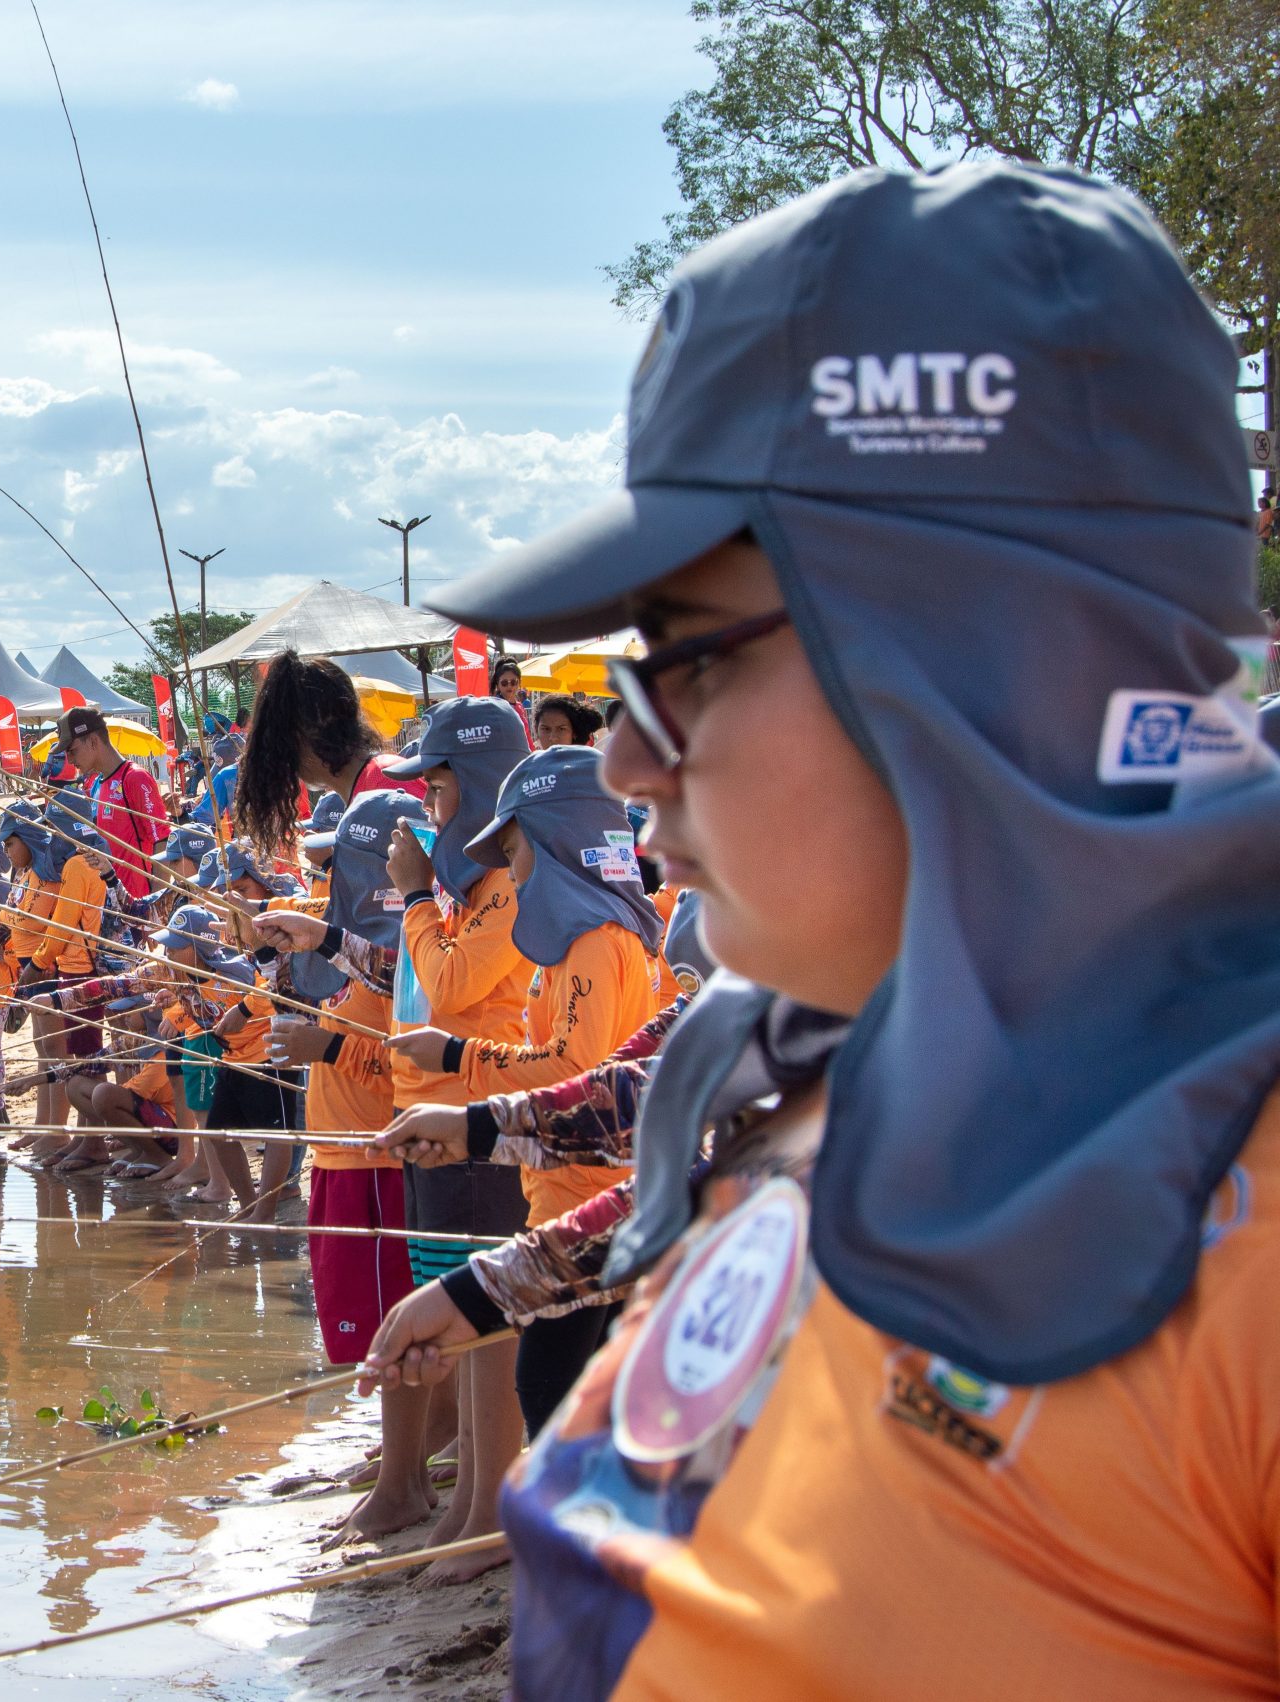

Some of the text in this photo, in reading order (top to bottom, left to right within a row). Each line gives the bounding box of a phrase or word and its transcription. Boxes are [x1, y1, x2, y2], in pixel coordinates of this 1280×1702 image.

[811, 352, 1017, 416] SMTC
[456, 725, 491, 740] SMTC
[522, 774, 557, 793] SMTC
[329, 811, 343, 819] SMT
[349, 823, 378, 838] SMTC
[464, 892, 510, 934] Juntos
